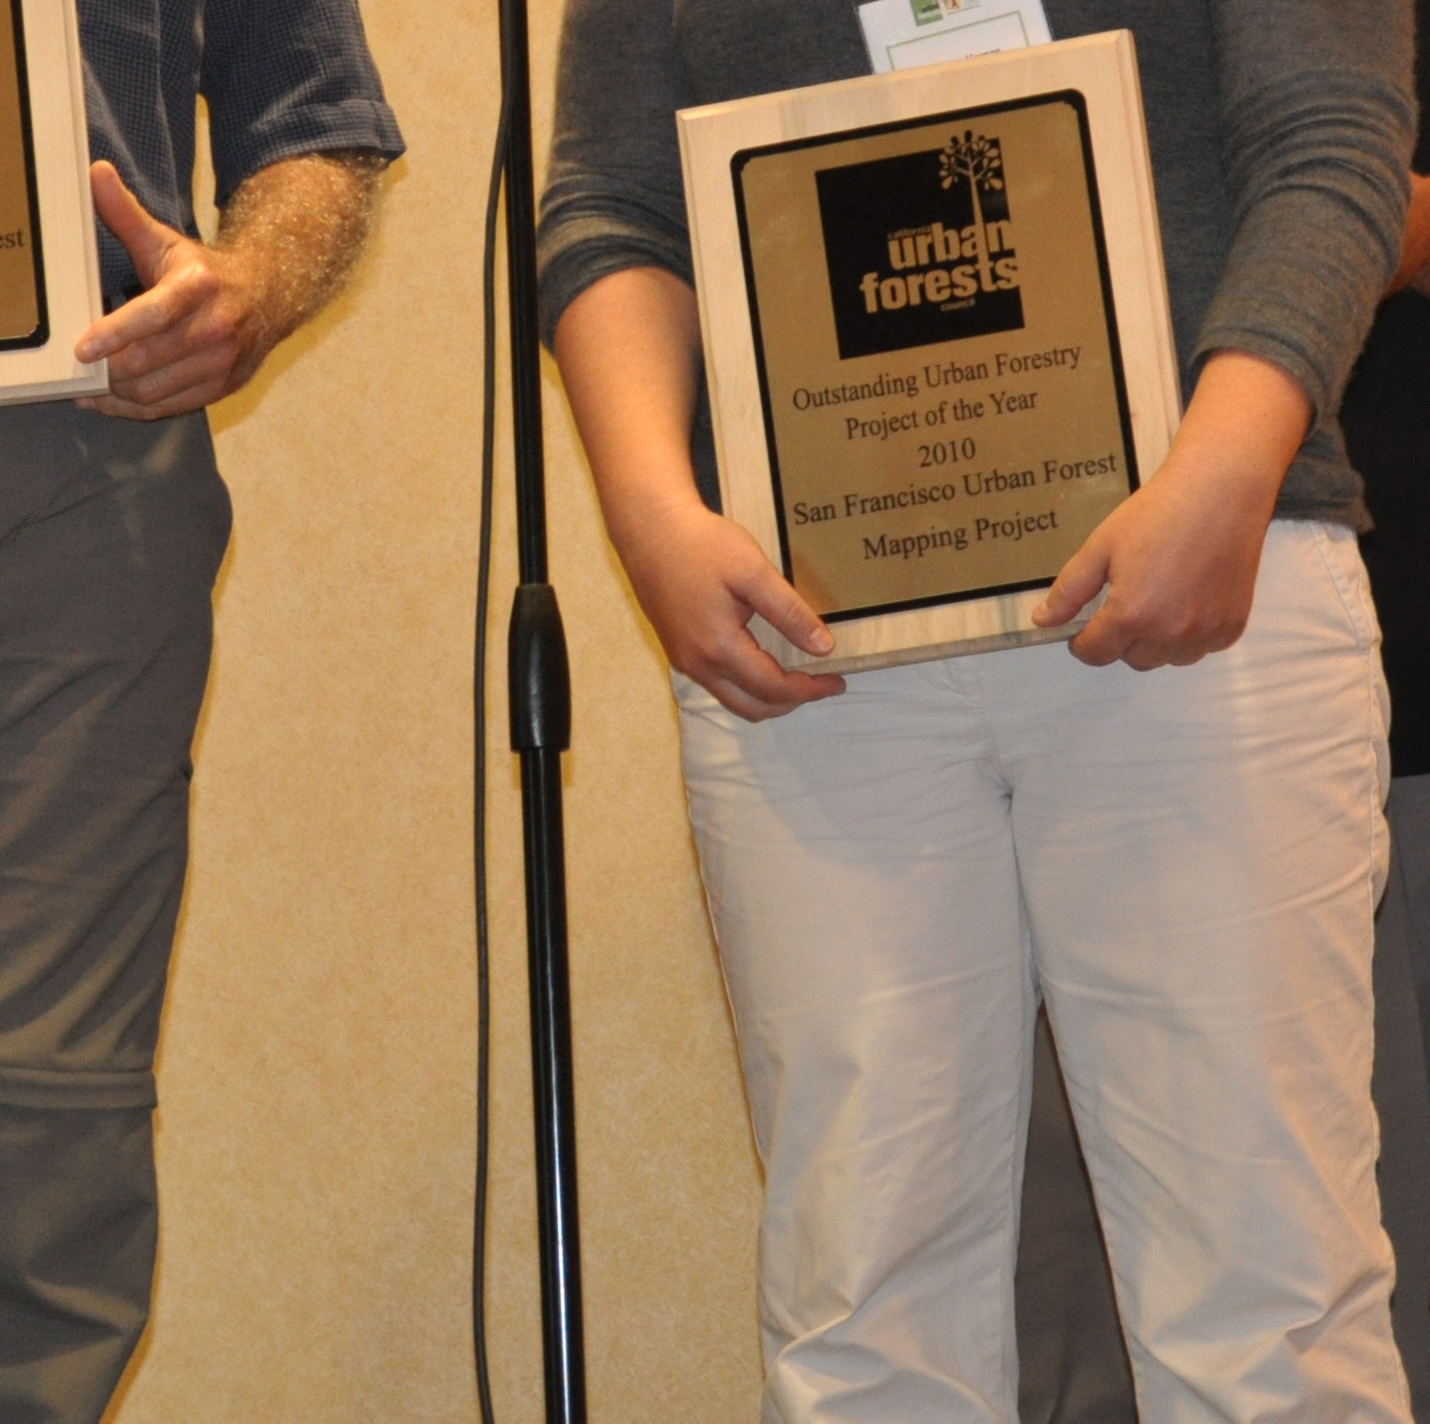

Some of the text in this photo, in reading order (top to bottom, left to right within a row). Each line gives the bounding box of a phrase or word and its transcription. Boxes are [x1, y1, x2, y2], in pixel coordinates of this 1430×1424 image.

[887, 219, 1016, 271] urban
[858, 256, 1021, 314] forests
[792, 346, 1082, 411] Outstanding Urban Forestry
[845, 390, 1038, 440] Project of the Year
[918, 437, 977, 468] 2010
[793, 452, 1117, 526] San Francisco Urban Forest
[862, 509, 1059, 560] Mapping Project
